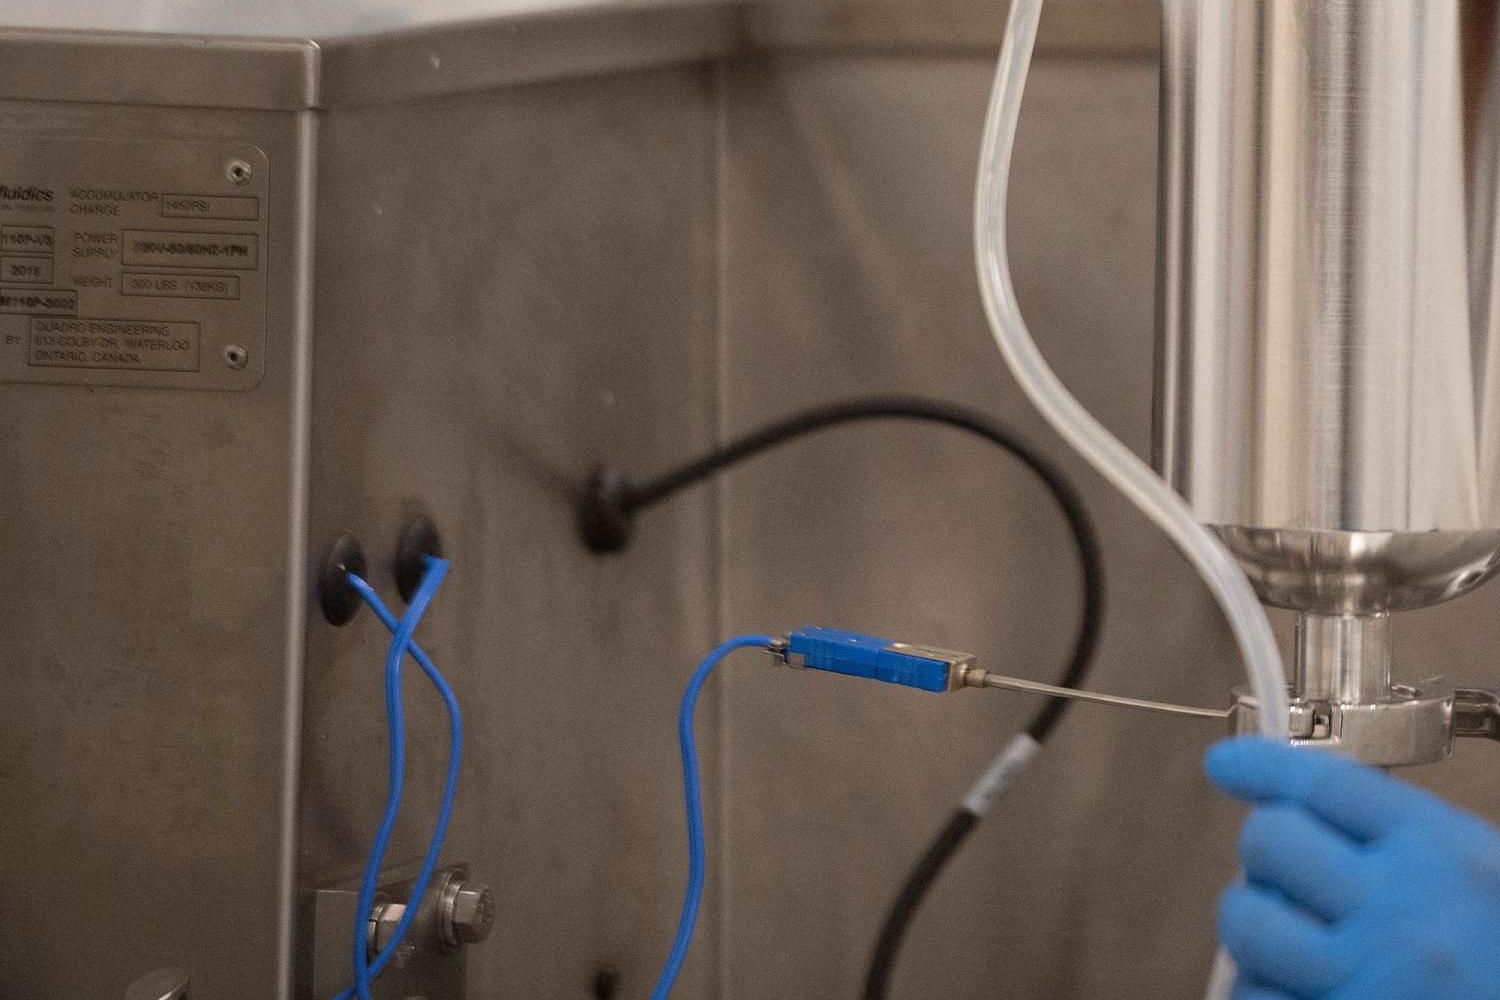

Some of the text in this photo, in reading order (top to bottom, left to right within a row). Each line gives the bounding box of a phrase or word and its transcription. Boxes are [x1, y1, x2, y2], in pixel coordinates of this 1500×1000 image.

[70, 189, 159, 201] ACCUMULATOR
[70, 203, 121, 216] CHARGE
[74, 232, 119, 245] POWER
[72, 248, 118, 259] SUPPLY
[72, 277, 113, 289] WEIGHT
[125, 339, 191, 351] WATERLOO
[92, 351, 140, 364] CANADA
